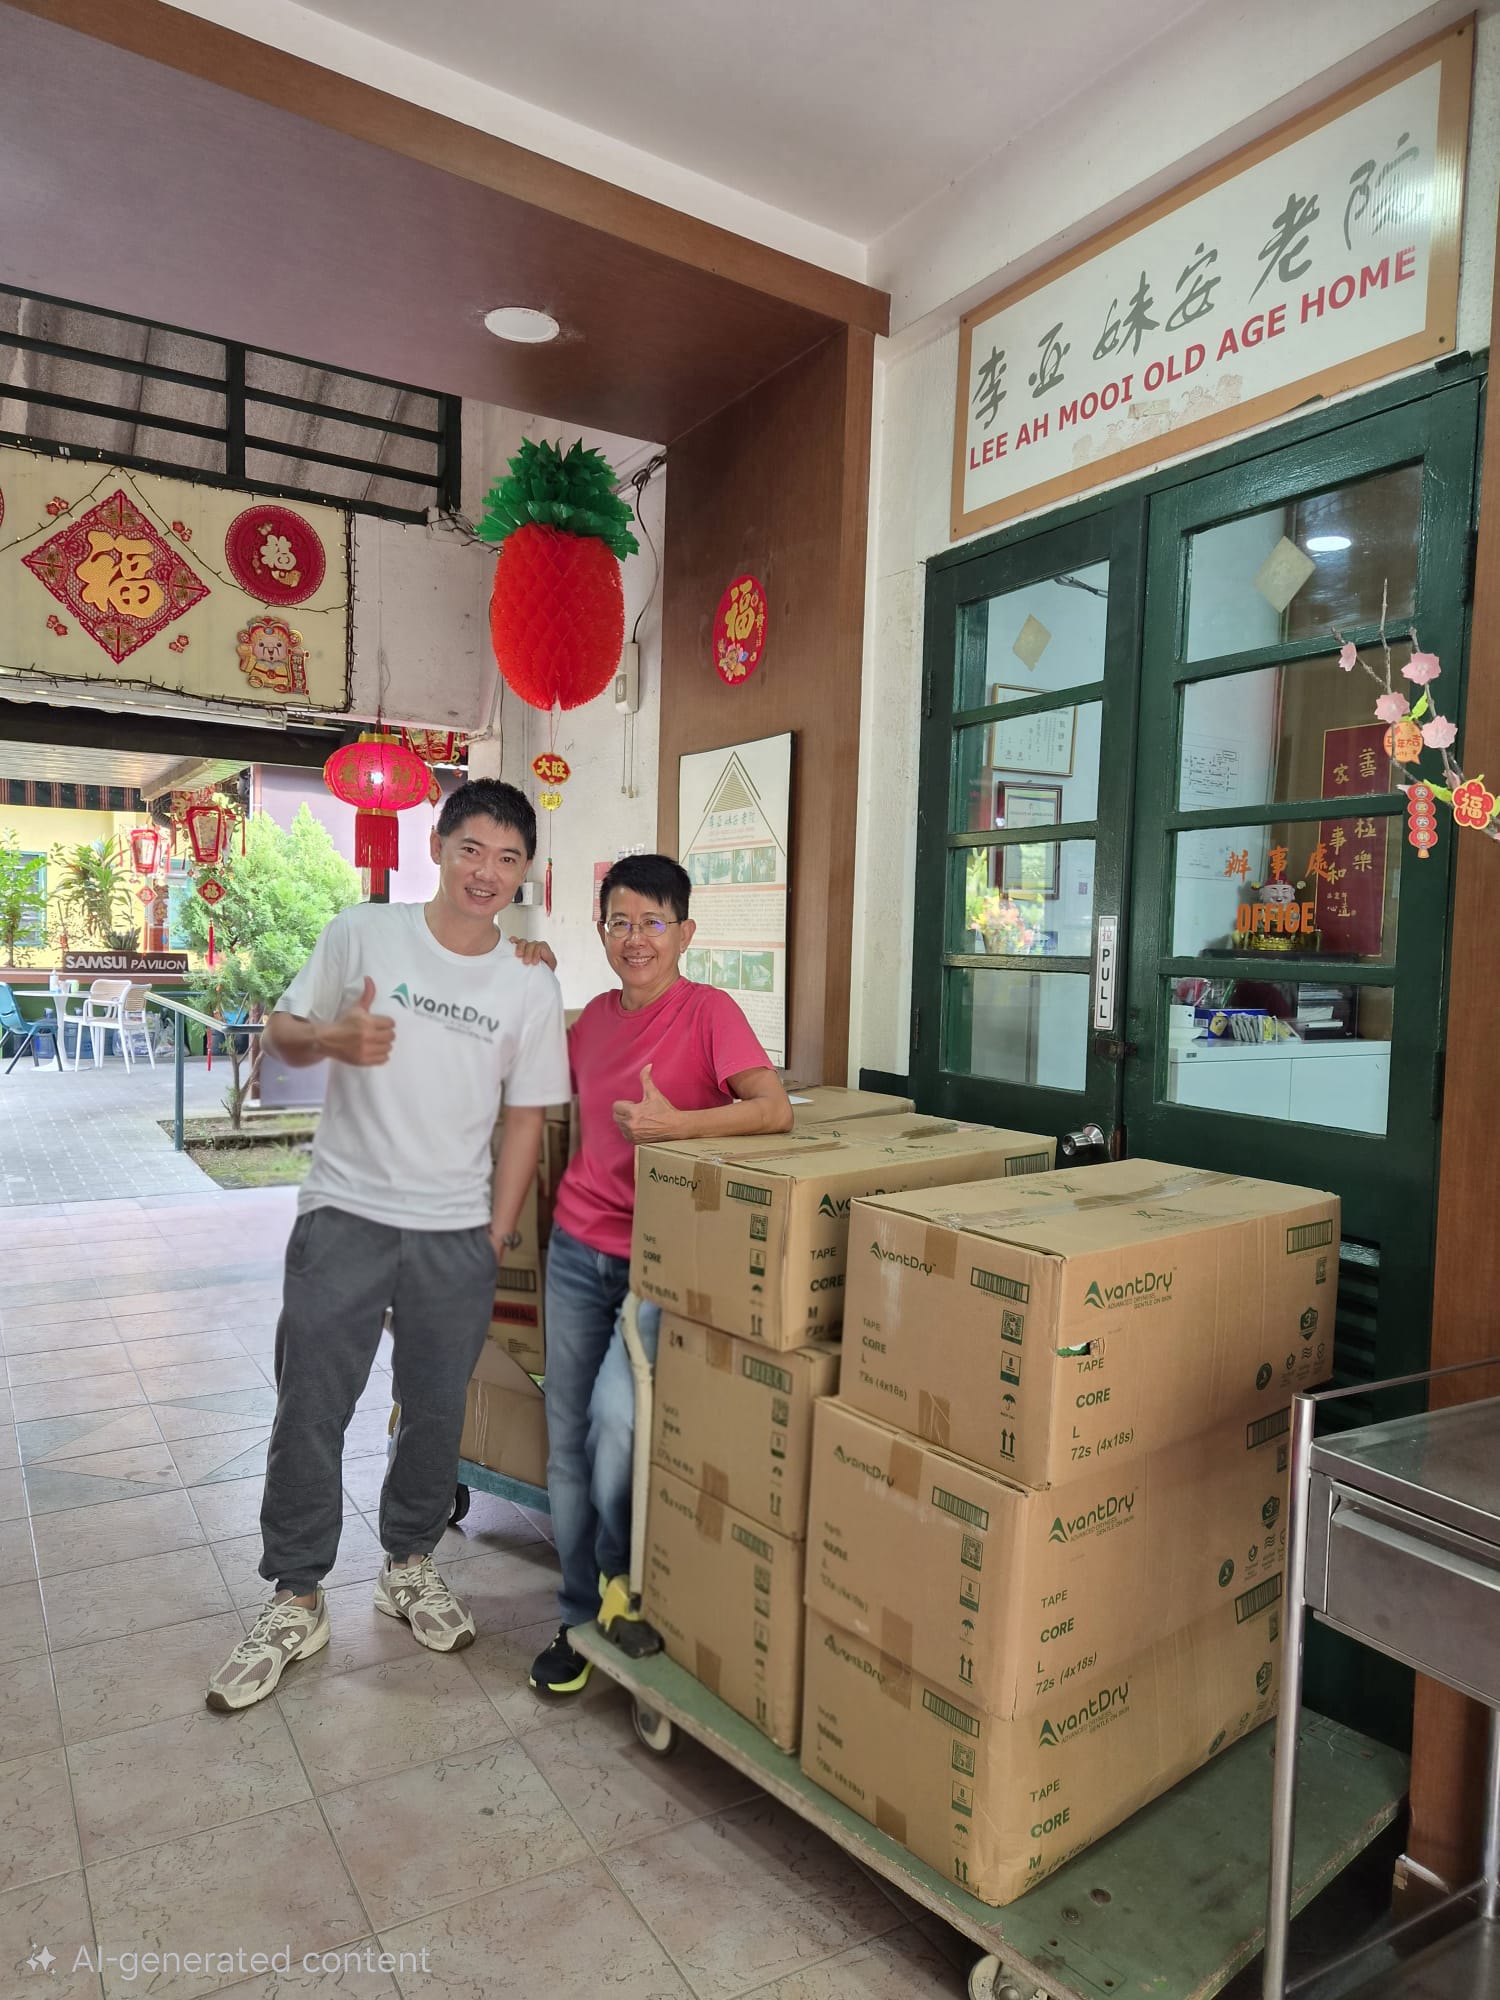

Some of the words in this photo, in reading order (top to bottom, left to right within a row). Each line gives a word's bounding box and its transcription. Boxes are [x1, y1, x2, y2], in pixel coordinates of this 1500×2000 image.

[969, 439, 1008, 470] LEE
[1014, 413, 1050, 450] AH
[1058, 373, 1133, 431] MOOI
[1143, 342, 1207, 391] OLD
[1216, 303, 1287, 360] AGE
[1300, 244, 1417, 324] HOME
[76, 530, 164, 619] 福
[536, 757, 567, 779] 大旺
[1352, 747, 1377, 873] 善極樂
[1459, 792, 1483, 819] 福
[1326, 763, 1350, 885] 家事和
[1236, 901, 1315, 933] OFFICE
[65, 955, 127, 969] SAMSUI
[130, 959, 187, 970] PAVILION
[1099, 948, 1111, 1019] PULL
[810, 1246, 837, 1261] TAPE
[869, 1241, 933, 1276] AvantDry
[810, 1274, 846, 1293] CORE
[1083, 1271, 1173, 1310] AvantDry
[863, 1317, 881, 1332] TAPE
[861, 1335, 887, 1355] CORE
[1077, 1357, 1105, 1373] TAPE
[1076, 1387, 1111, 1408] CORE
[1071, 1445, 1092, 1461] 72s
[1096, 1427, 1134, 1457] (4x18s)
[1072, 1425, 1081, 1440] L
[1047, 1487, 1134, 1543] AvantDry
[1040, 1589, 1069, 1609] TAPE
[1040, 1617, 1075, 1643] CORE
[1035, 1678, 1055, 1697] 72s
[1060, 1650, 1098, 1686] (4x18s)
[1037, 1660, 1045, 1674] L
[1039, 1680, 1129, 1748] AvantDry
[1029, 1779, 1060, 1803] TAPE
[1030, 1807, 1070, 1839] CORE
[1029, 1853, 1043, 1871] M
